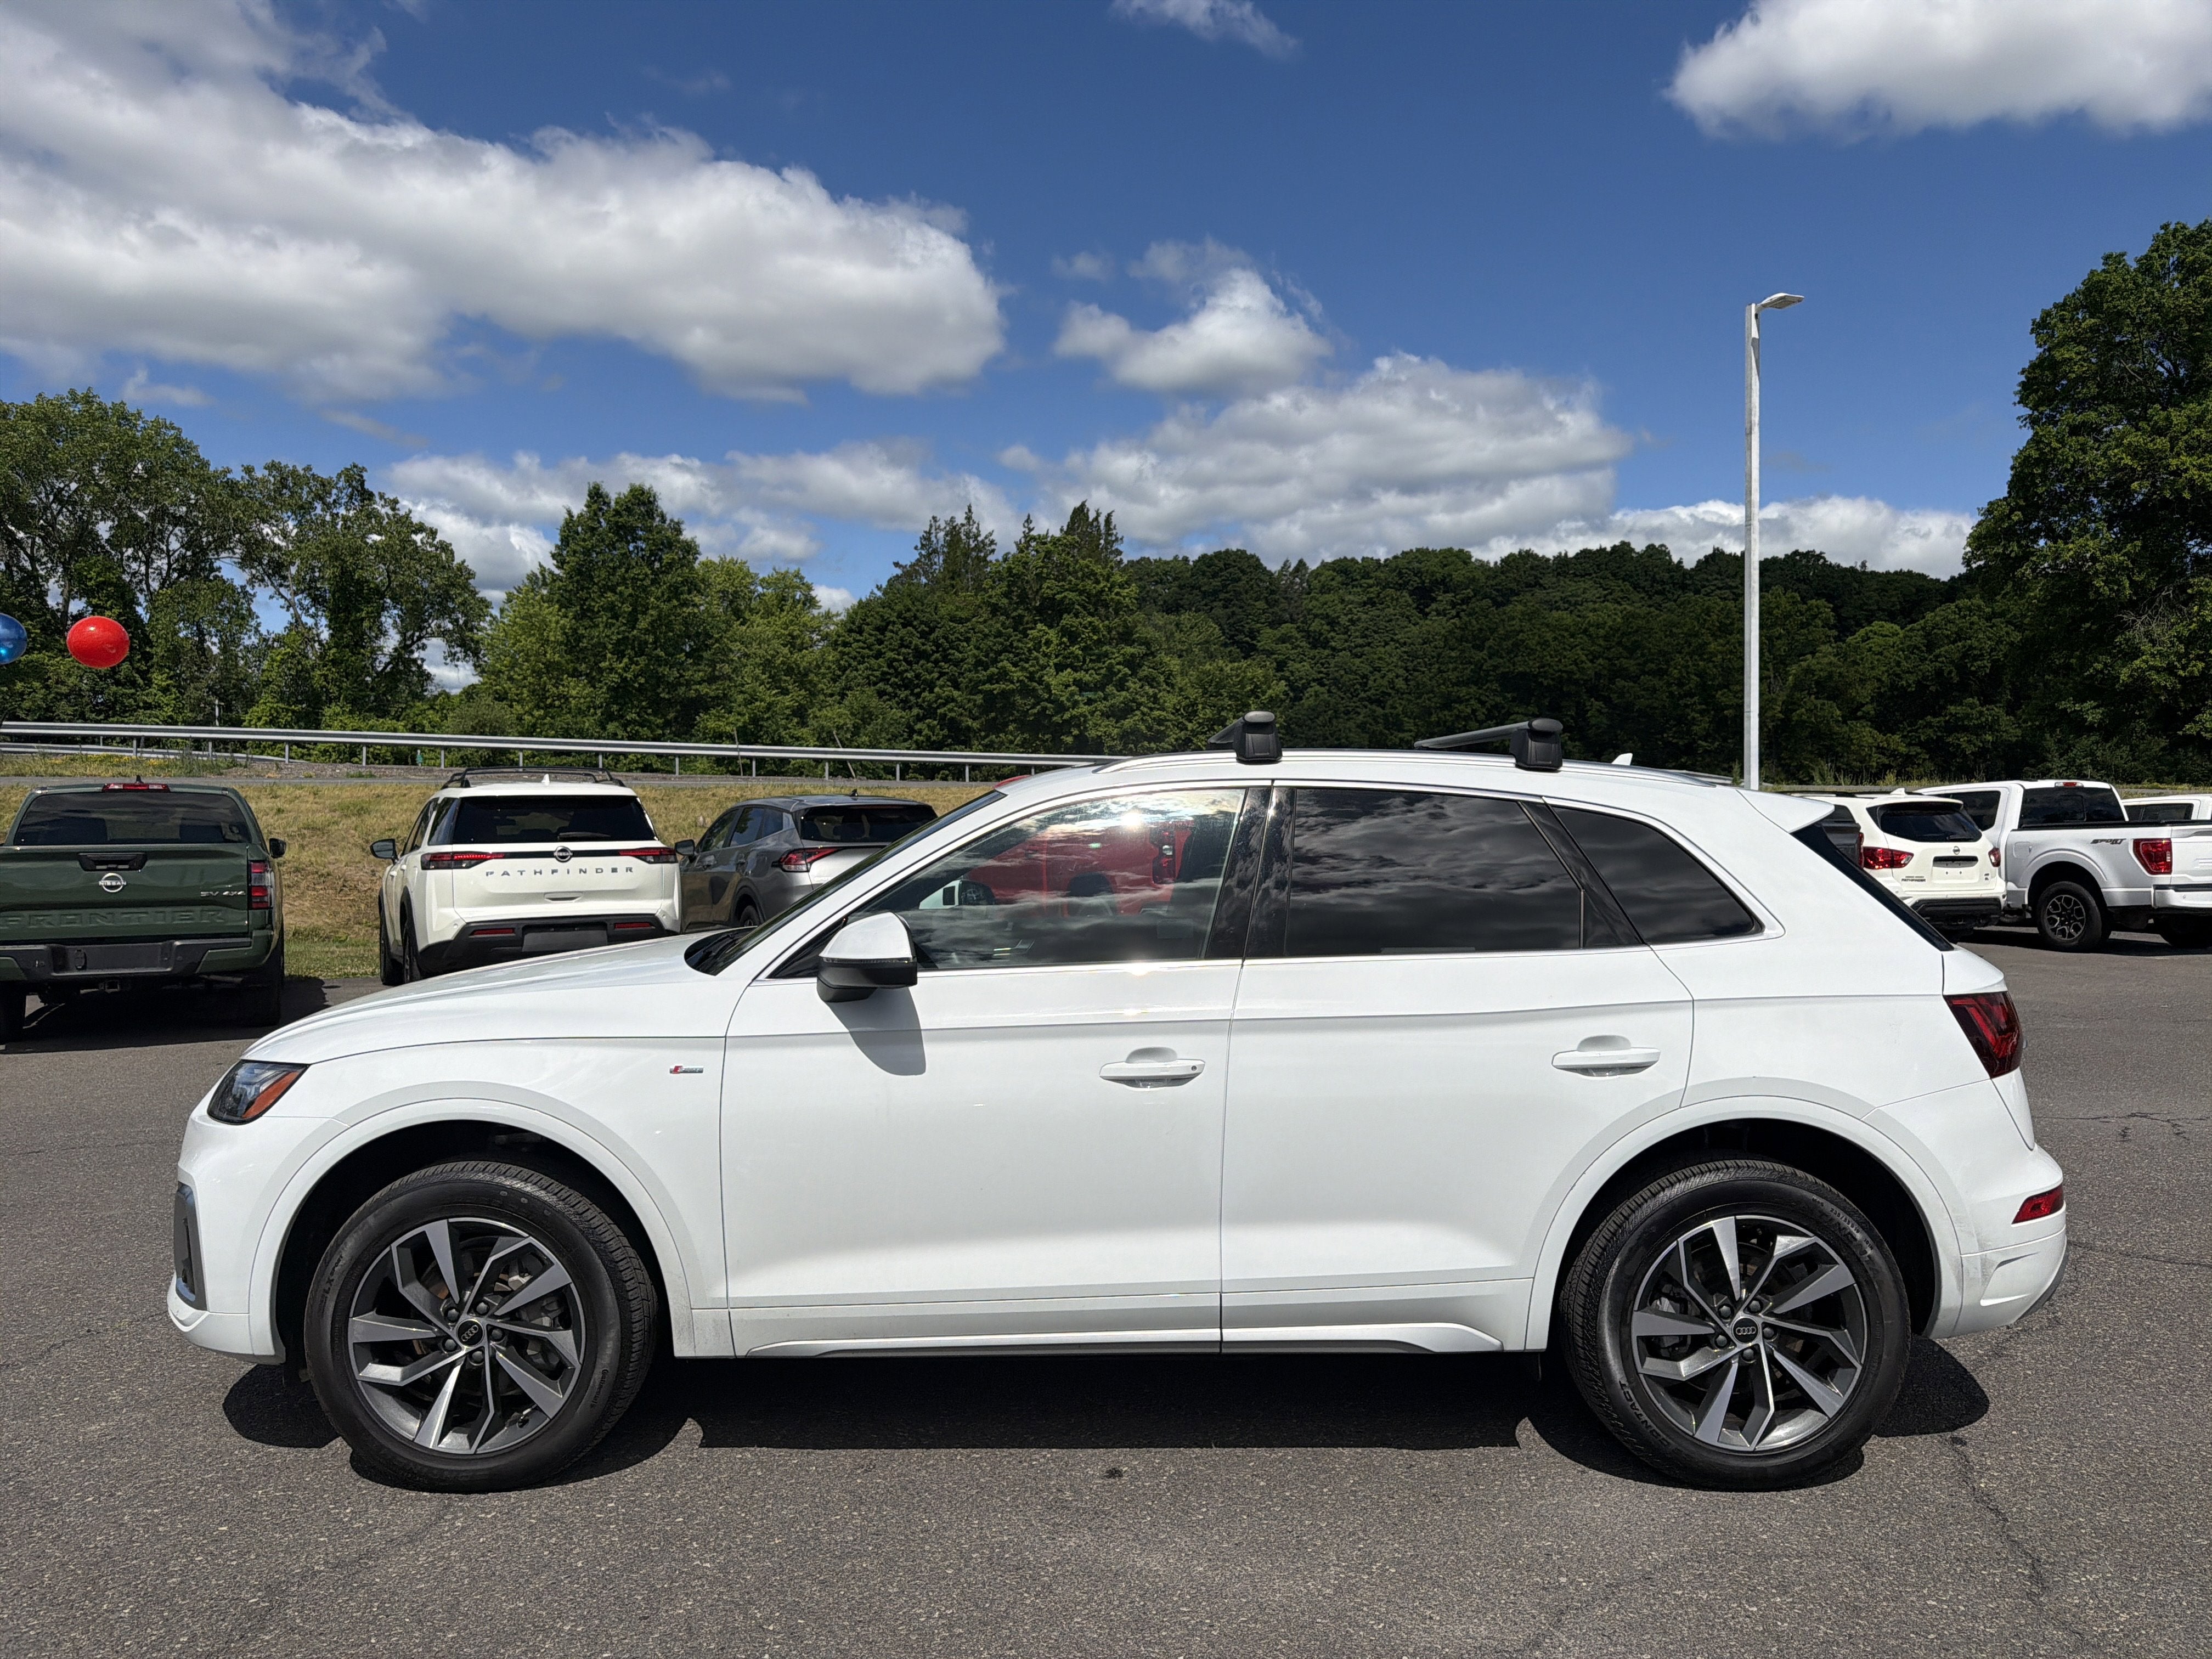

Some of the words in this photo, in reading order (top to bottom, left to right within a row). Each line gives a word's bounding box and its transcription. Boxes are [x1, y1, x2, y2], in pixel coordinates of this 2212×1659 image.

[486, 866, 634, 877] PATHFINDER
[0, 909, 225, 929] FRONTIER
[1619, 1380, 1671, 1446] CONTACT
